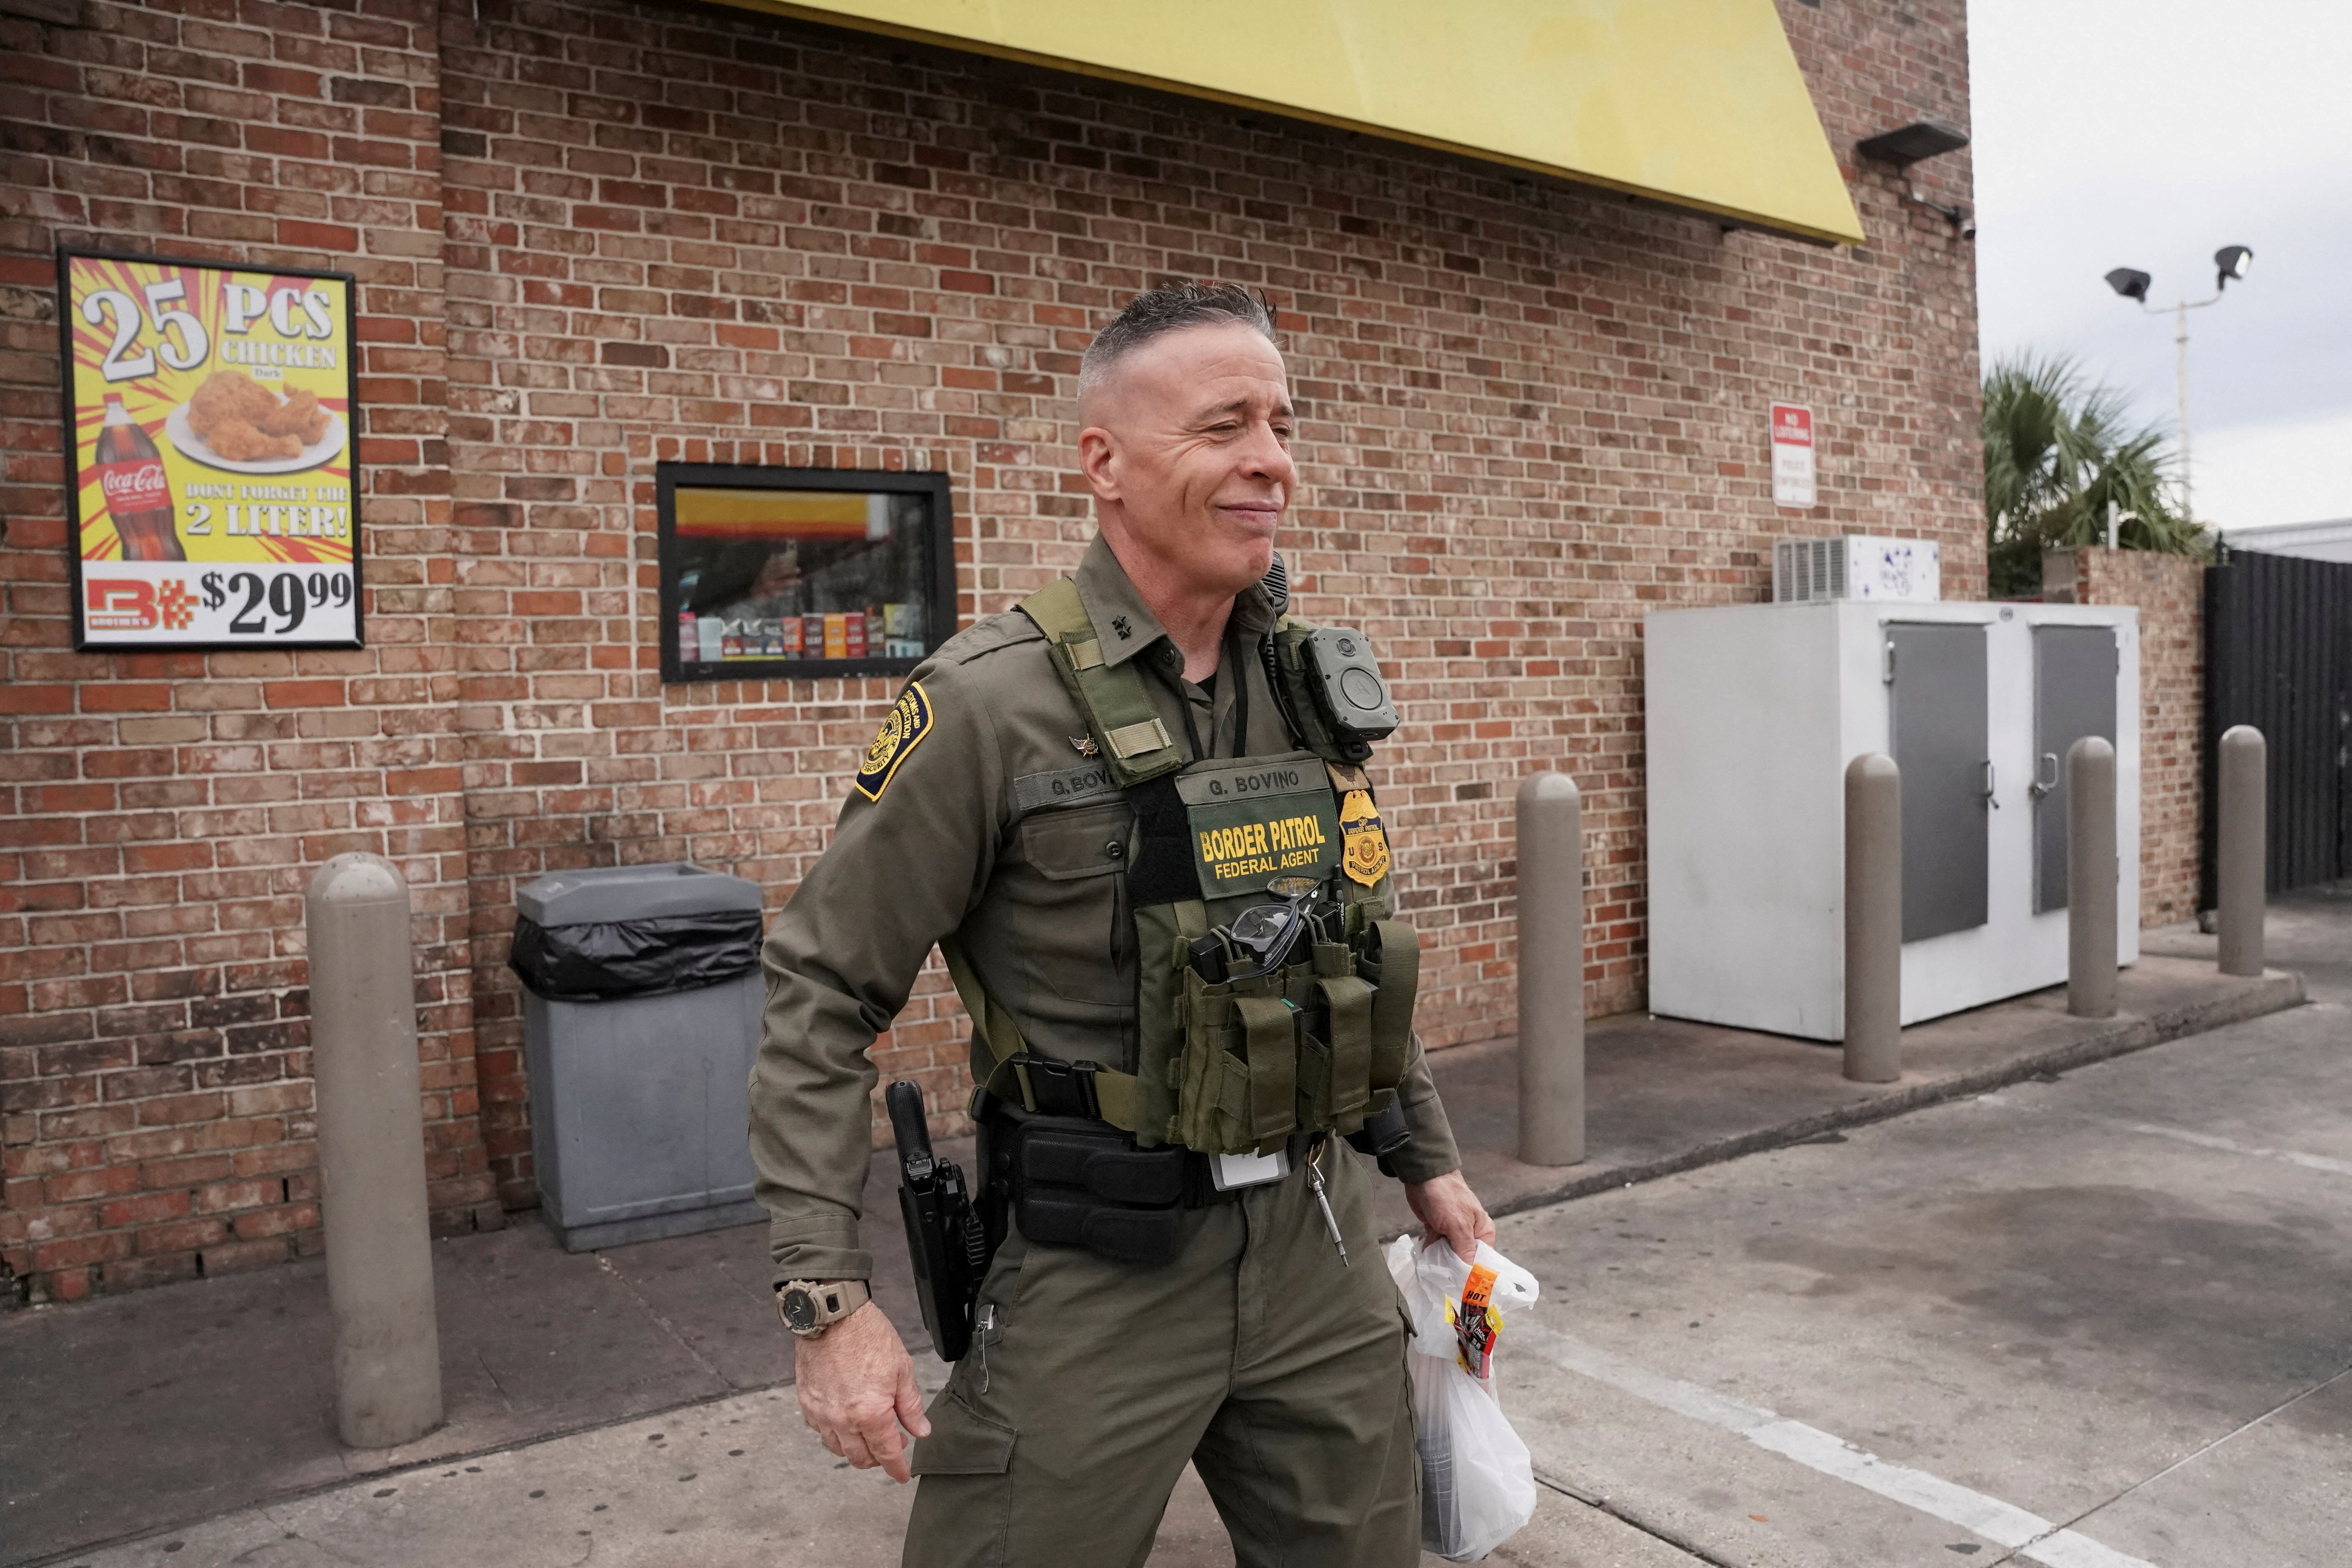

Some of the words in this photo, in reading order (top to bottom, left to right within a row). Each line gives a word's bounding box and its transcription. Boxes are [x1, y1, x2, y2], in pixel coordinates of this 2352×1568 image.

[223, 283, 332, 340] PCS
[82, 278, 209, 383] 25
[221, 340, 336, 370] CHICKEN
[1784, 412, 1799, 427] NO
[240, 484, 308, 501] FORGET
[315, 486, 348, 502] THE
[186, 503, 212, 536] 2
[225, 504, 347, 537] LITER!
[864, 753, 889, 772] SECURITY
[1209, 780, 1228, 795] G.
[1235, 771, 1299, 792] BOVINO
[1348, 826, 1365, 834] BORDER
[1358, 818, 1368, 826] CBP
[1200, 824, 1269, 862] BORDER
[1269, 815, 1325, 851] PATROL
[1348, 846, 1355, 856] U
[1378, 842, 1383, 851] S
[1215, 856, 1278, 879] FEDERAL
[1280, 848, 1319, 869] AGENT
[1352, 861, 1371, 874] PATROL
[1371, 856, 1385, 874] AGENT
[1466, 1290, 1486, 1302] HOT
